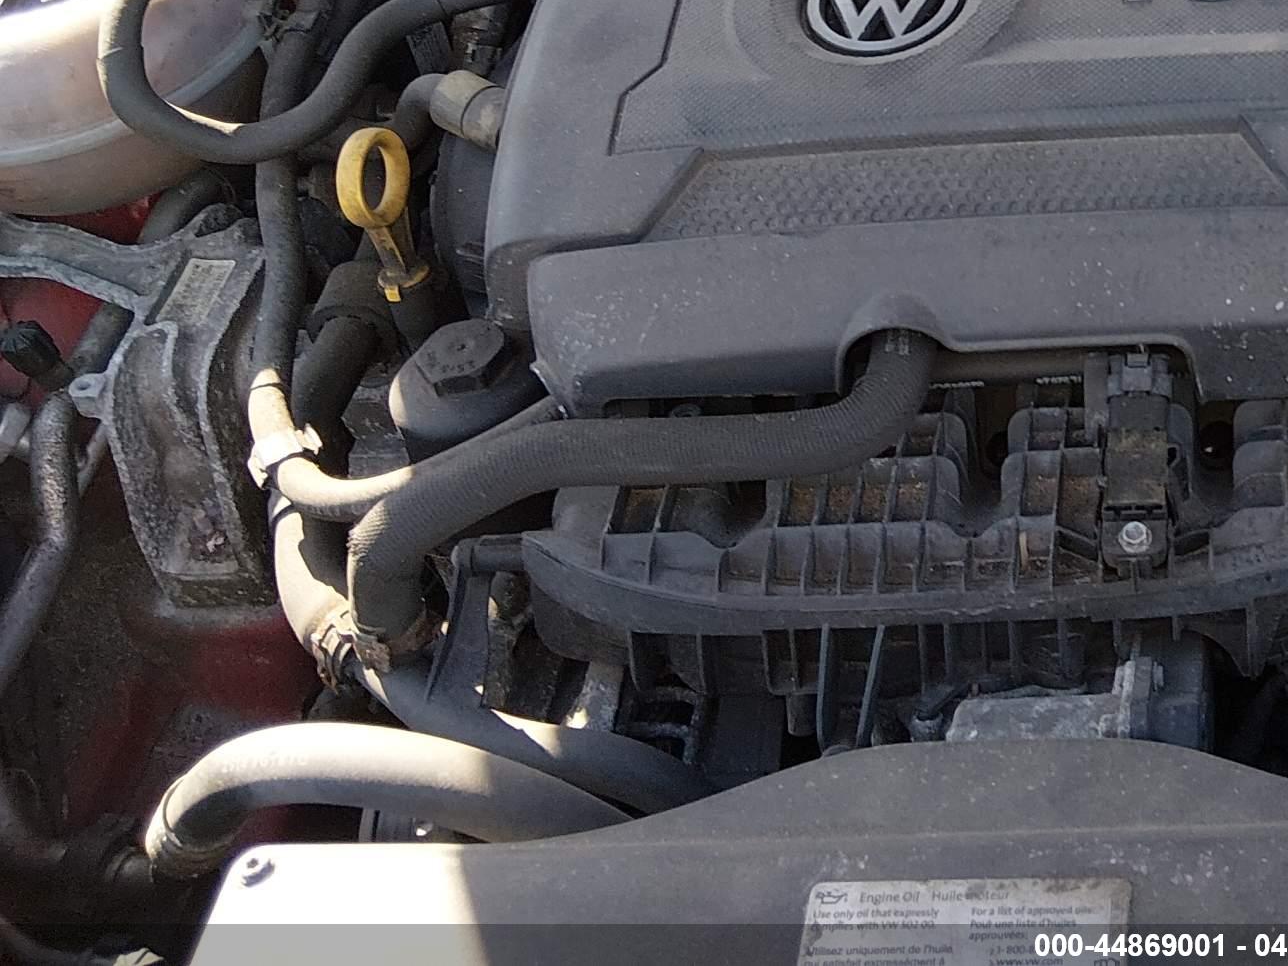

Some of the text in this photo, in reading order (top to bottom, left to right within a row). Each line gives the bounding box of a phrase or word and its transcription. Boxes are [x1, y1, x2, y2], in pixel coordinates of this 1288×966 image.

[860, 892, 900, 905] Engine
[902, 891, 920, 903] Oil
[932, 890, 962, 902] Huile
[813, 906, 940, 922] Use only oil that expressly
[971, 906, 986, 917] For
[998, 905, 1012, 916] list
[1015, 905, 1026, 915] of
[1028, 905, 1073, 918] approved
[857, 920, 879, 931] with
[881, 920, 899, 930] VW
[846, 946, 904, 958] uniquement
[908, 946, 921, 955] de
[996, 958, 1063, 966] www.vw.com
